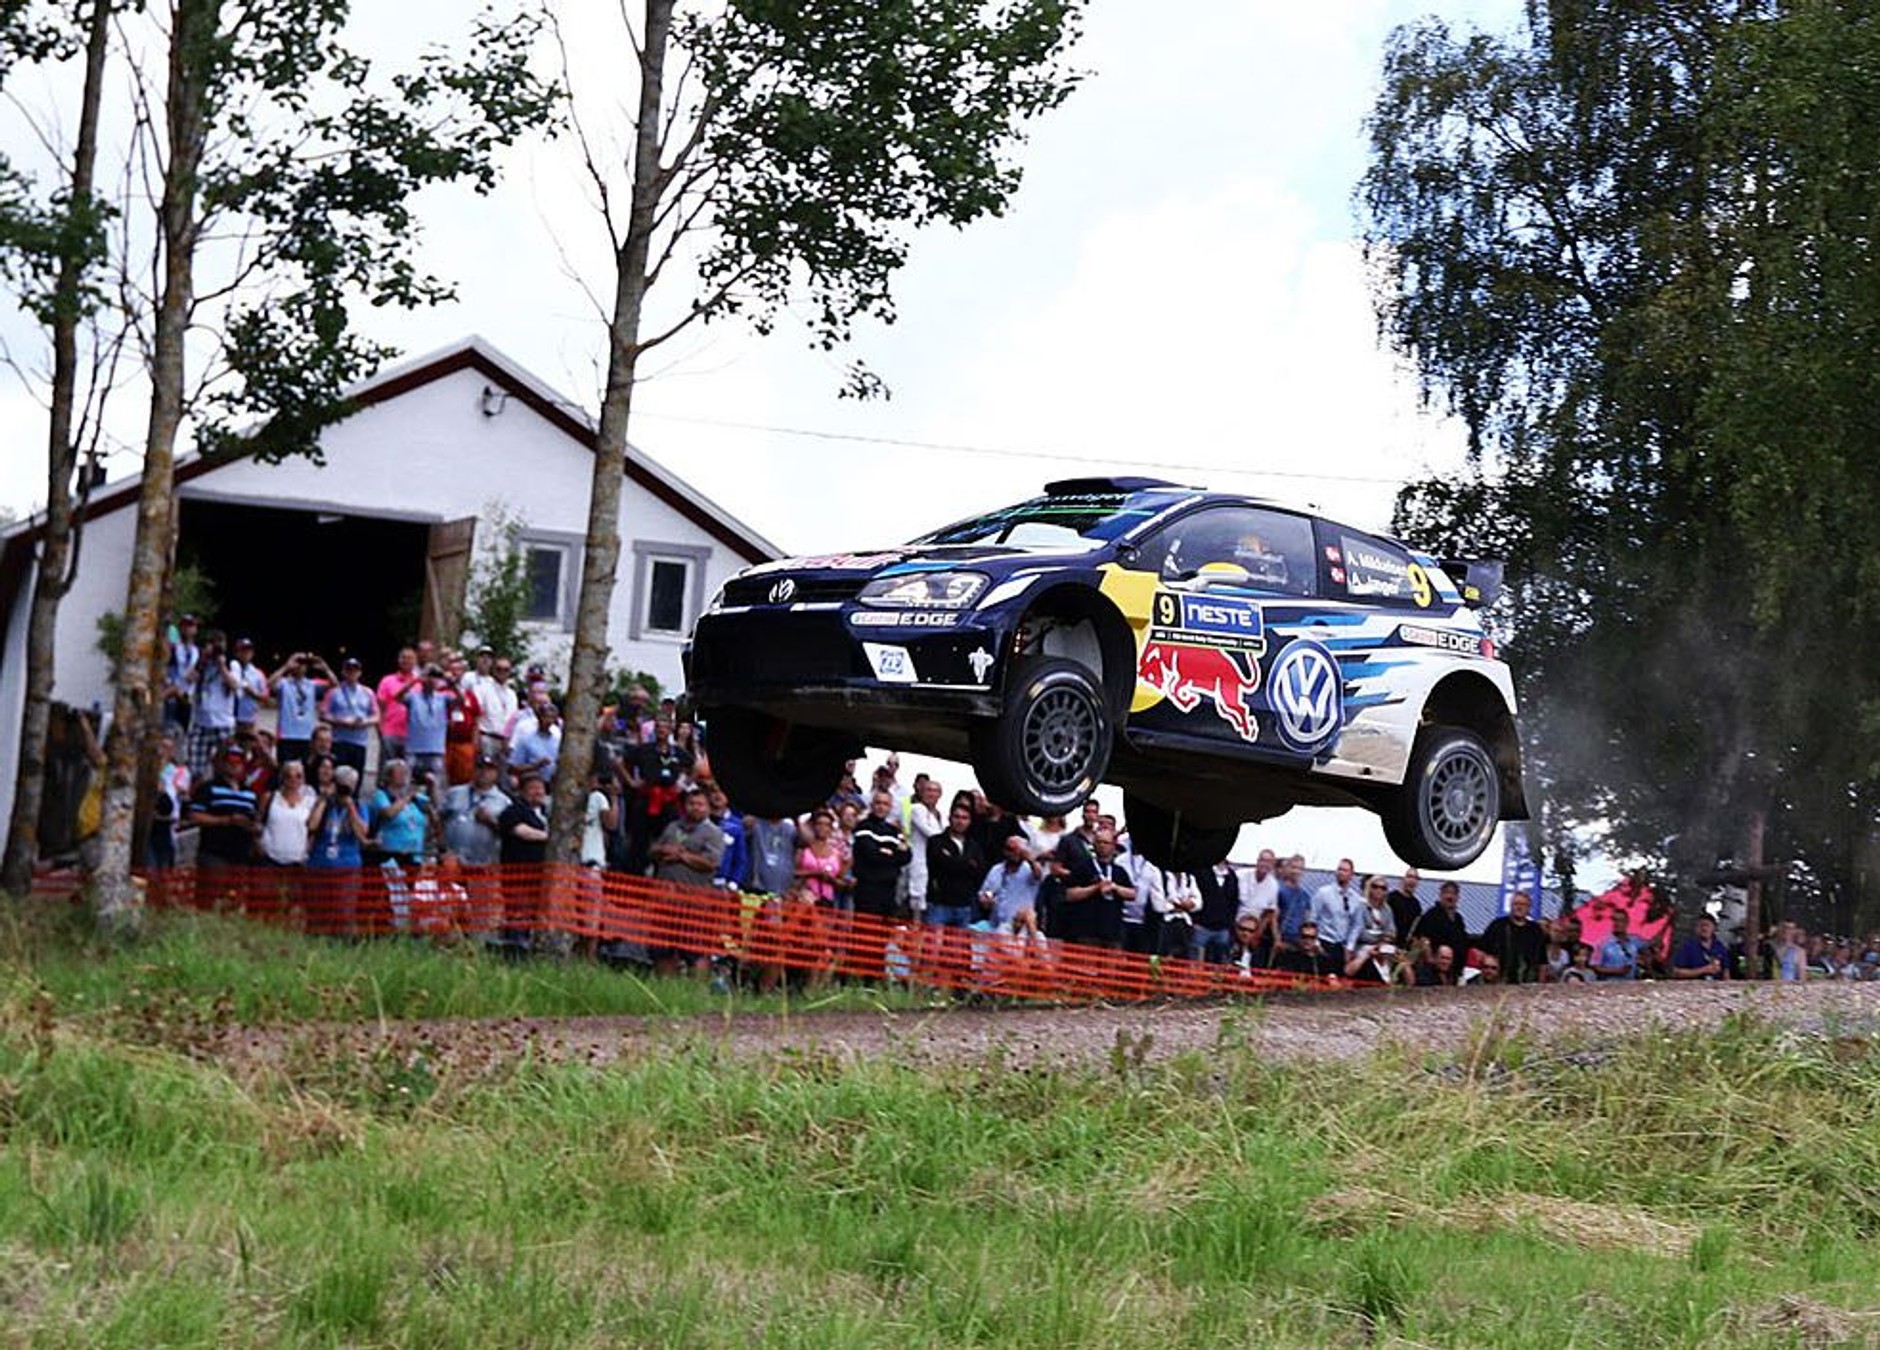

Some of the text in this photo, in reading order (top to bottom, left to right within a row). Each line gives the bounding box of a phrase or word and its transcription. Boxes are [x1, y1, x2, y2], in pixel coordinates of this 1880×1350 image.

[1407, 562, 1431, 608] 9
[900, 613, 958, 627] EDGE
[1160, 595, 1174, 624] 9
[1187, 603, 1252, 627] NESTE
[1438, 632, 1480, 654] EDGE
